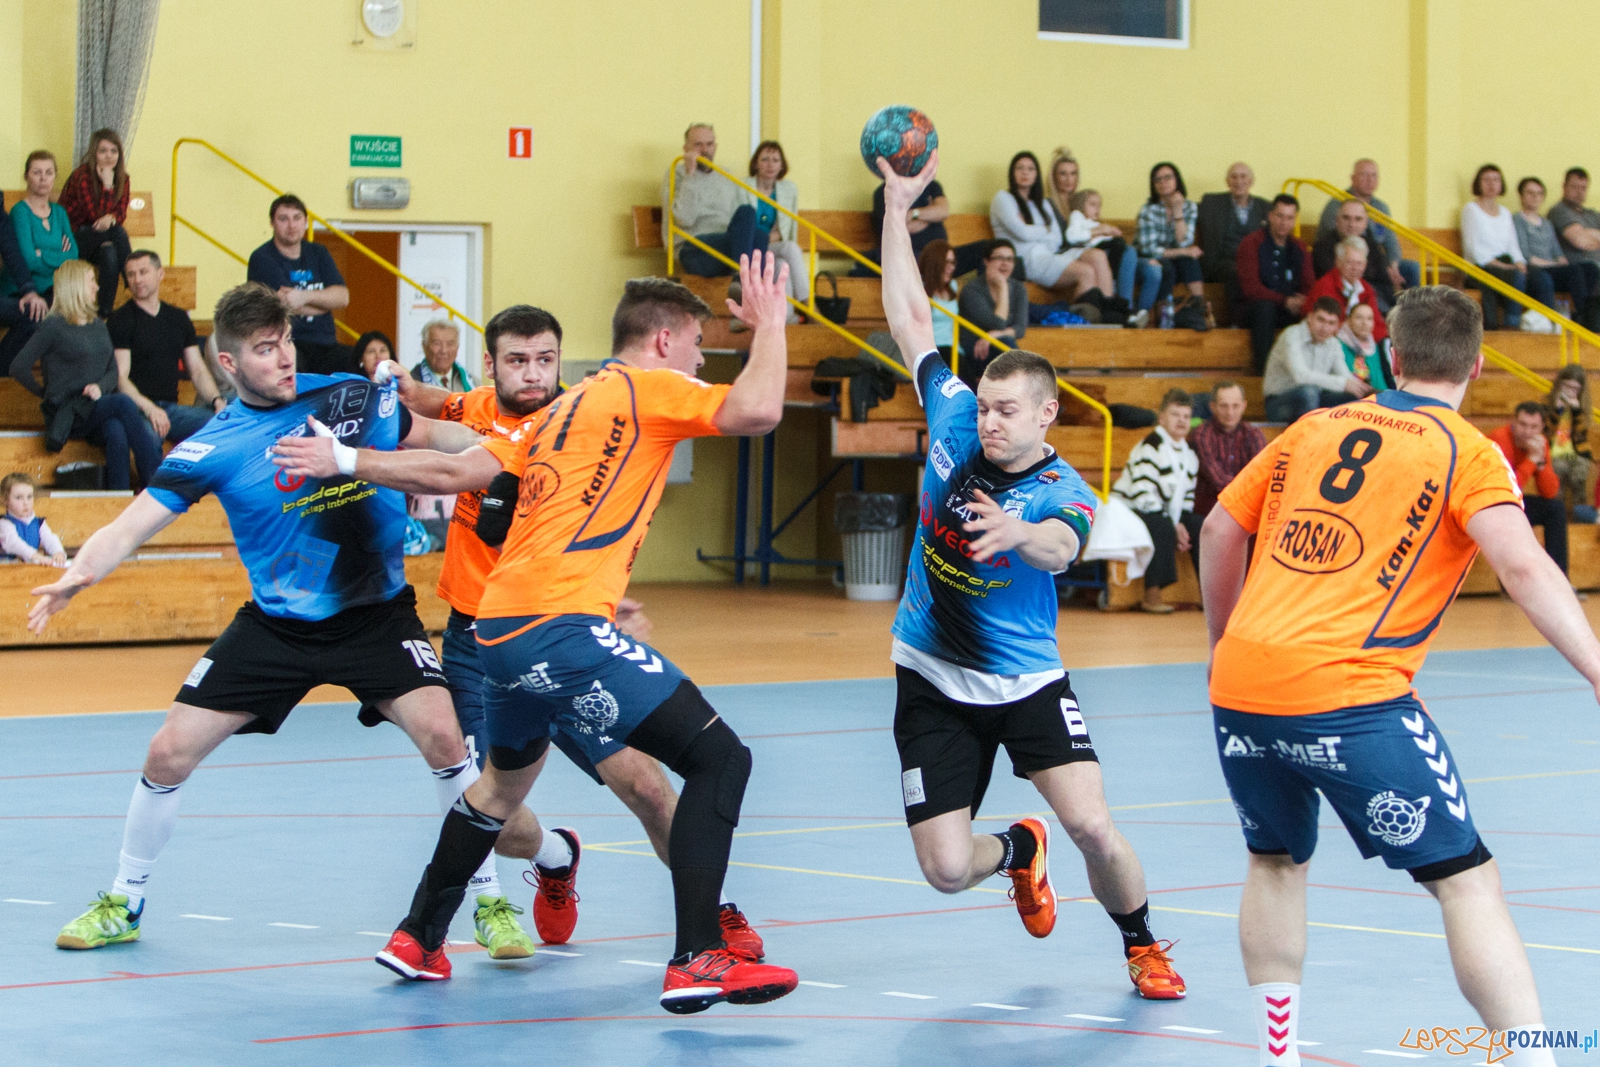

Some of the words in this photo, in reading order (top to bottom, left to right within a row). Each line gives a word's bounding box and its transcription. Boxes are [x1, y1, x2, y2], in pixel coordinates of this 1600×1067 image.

[580, 416, 627, 506] Kan-Kat
[1319, 428, 1383, 504] 8
[933, 517, 1011, 569] VEOIA
[1279, 520, 1346, 564] ROSAN
[1376, 478, 1440, 591] Kan-Kat
